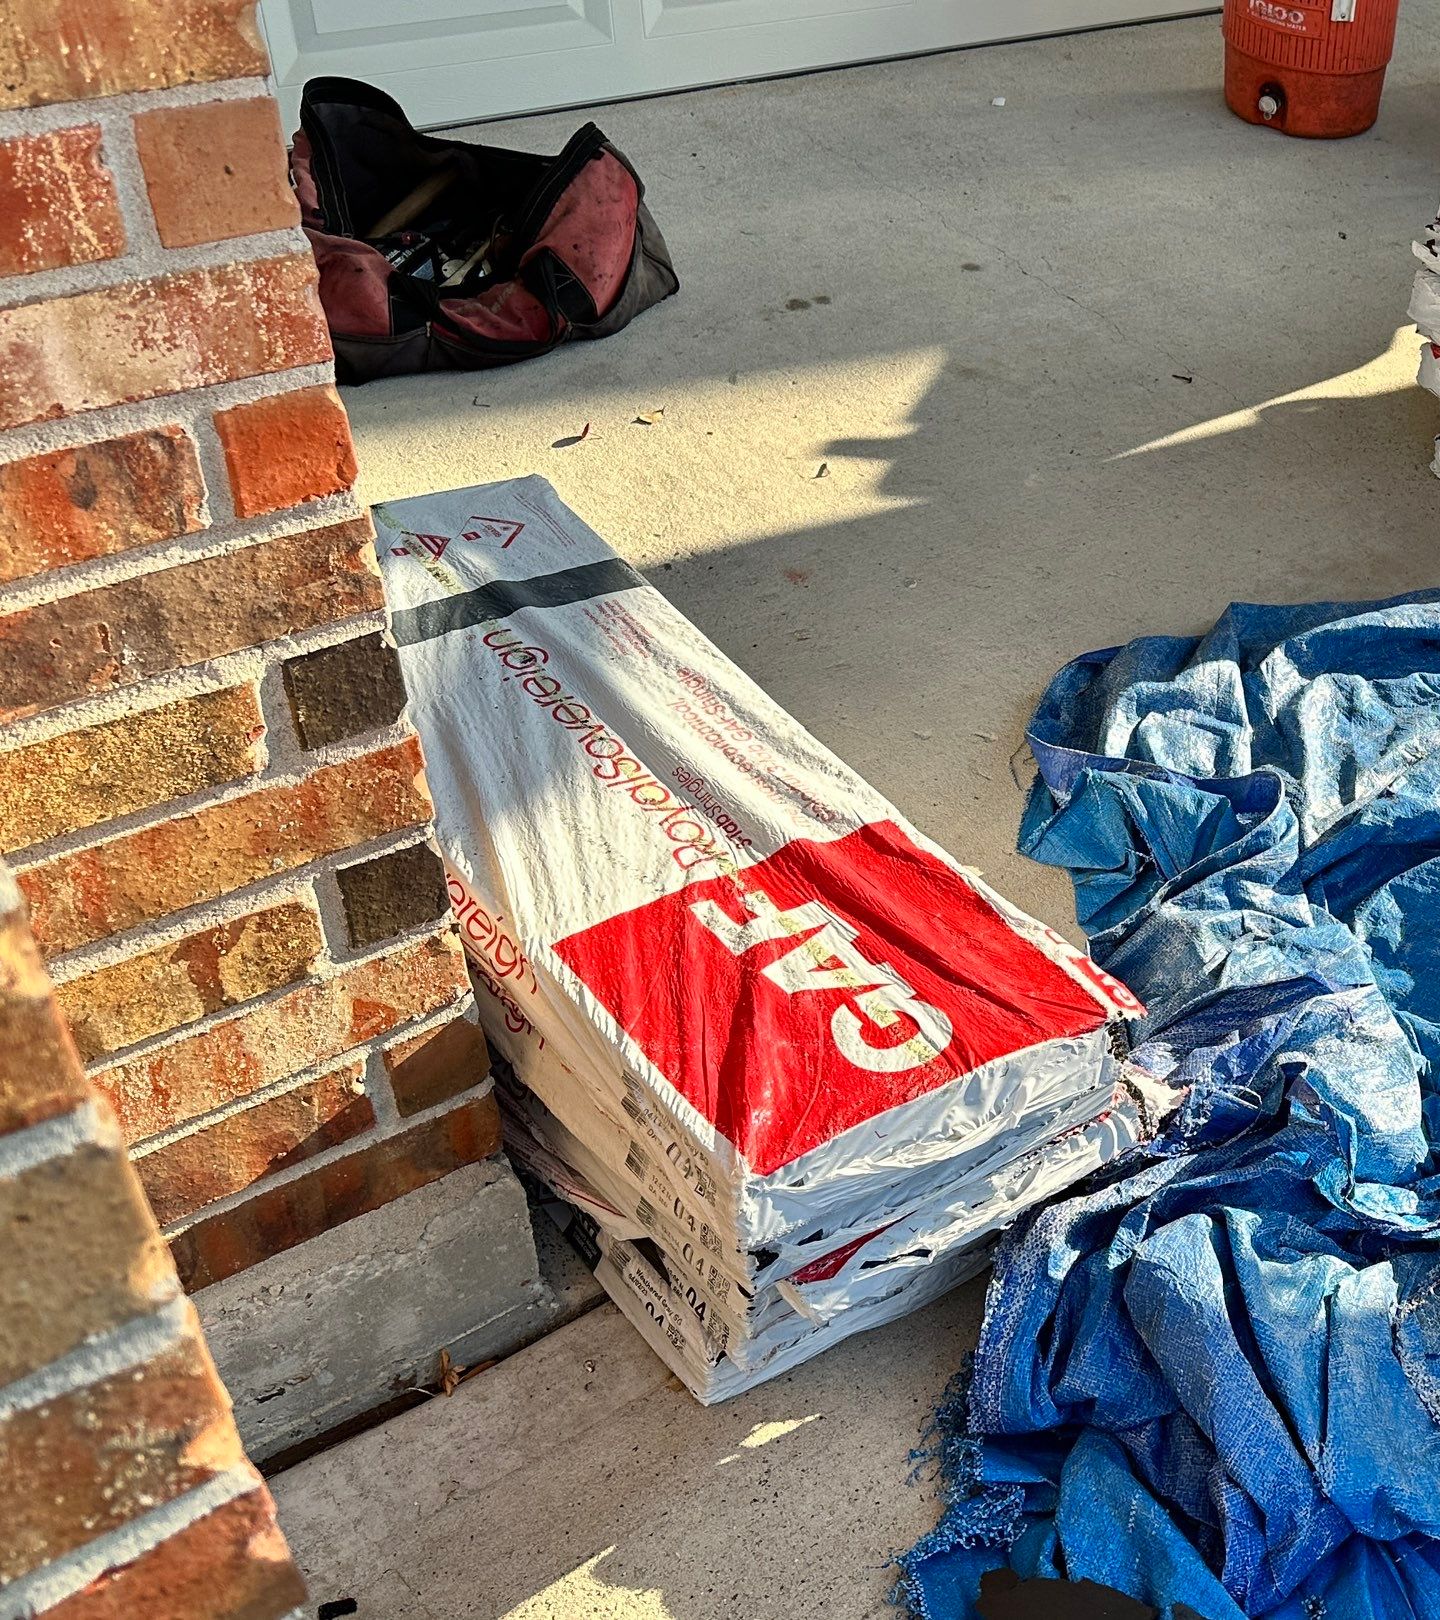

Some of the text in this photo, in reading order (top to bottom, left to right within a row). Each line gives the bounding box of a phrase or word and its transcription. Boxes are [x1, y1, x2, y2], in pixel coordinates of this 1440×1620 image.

[482, 628, 726, 871] RoyalSovereign
[446, 873, 538, 995] ereign
[688, 889, 954, 1072] GAF
[682, 1242, 704, 1277] 04
[685, 1286, 706, 1321] 04
